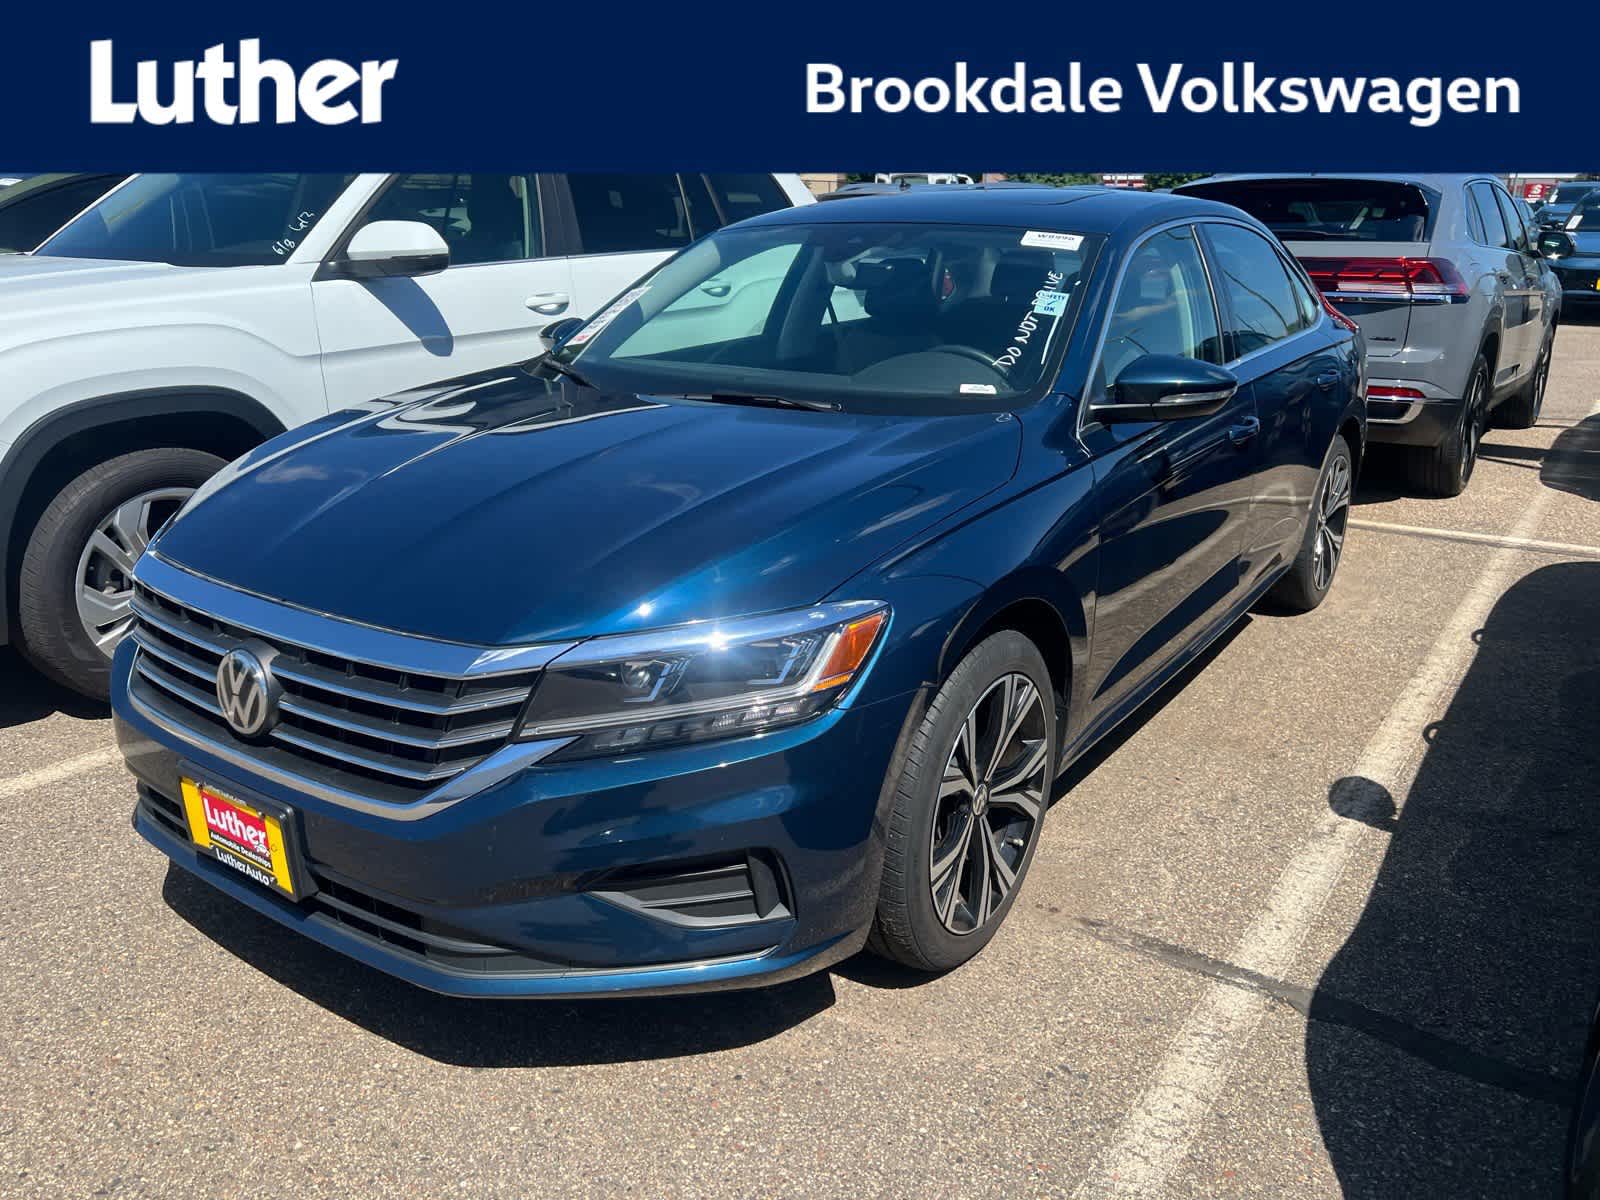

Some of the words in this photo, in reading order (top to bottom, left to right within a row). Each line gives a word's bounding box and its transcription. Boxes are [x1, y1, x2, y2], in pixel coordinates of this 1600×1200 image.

[1043, 305, 1056, 313] OK
[992, 346, 1022, 366] DO
[1014, 311, 1039, 344] NOT
[203, 797, 267, 846] Luther
[240, 845, 272, 869] Dealerships
